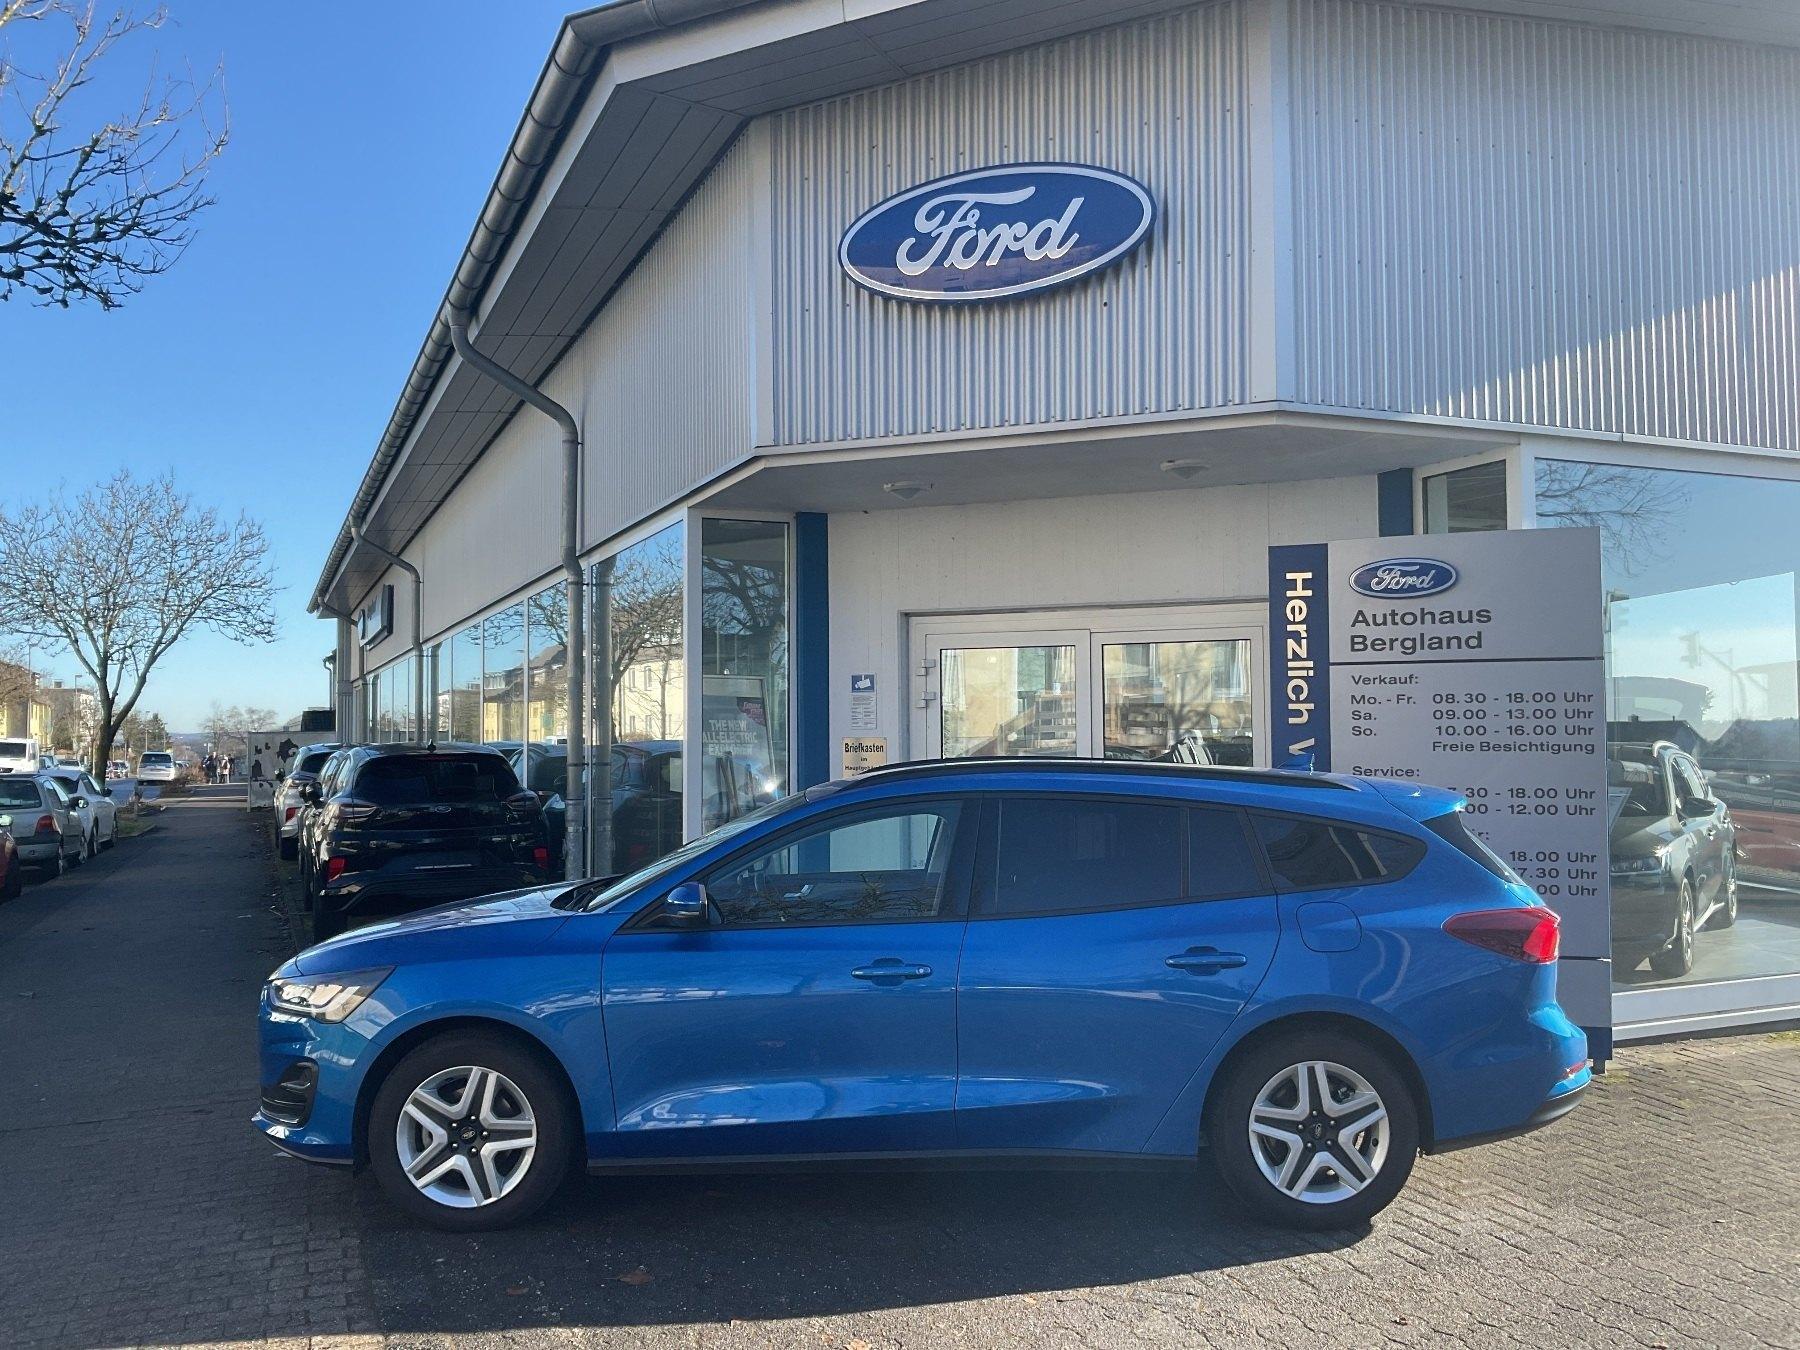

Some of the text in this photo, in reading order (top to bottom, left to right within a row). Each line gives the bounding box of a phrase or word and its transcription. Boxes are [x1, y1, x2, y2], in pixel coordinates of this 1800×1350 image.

[896, 186, 1084, 276] Ford
[1370, 565, 1436, 591] Ford
[1350, 607, 1492, 628] Autohaus
[1285, 572, 1315, 724] Herzlich
[1350, 630, 1483, 656] Bergland
[1351, 674, 1419, 685] Verkauf:
[1350, 694, 1382, 705] Mo.
[1396, 693, 1416, 704] Fr.
[1432, 692, 1487, 704] 08.30
[1506, 692, 1556, 703] 18.00
[1563, 692, 1594, 703] Uhr
[1351, 709, 1377, 720] Sa.
[1432, 709, 1487, 720] 09.00
[1506, 708, 1557, 719] 13.00
[1564, 708, 1594, 719] Uhr
[1351, 725, 1377, 736] So.
[1435, 725, 1487, 736] 10.00
[1506, 724, 1557, 736] 16.00
[1564, 725, 1594, 736] Uhr
[844, 742, 884, 753] Briefkasten
[1432, 741, 1595, 755] Freie Besichtigung
[1352, 766, 1420, 777] Service:
[1507, 788, 1558, 799] 18.00
[1566, 788, 1596, 799] Uhr
[1508, 804, 1559, 815] 12.00
[1566, 804, 1596, 816] Uhr
[1509, 851, 1597, 863] 18.00 Uhr
[1513, 868, 1598, 880] 7.30 Uhr
[1568, 884, 1598, 896] Uhr
